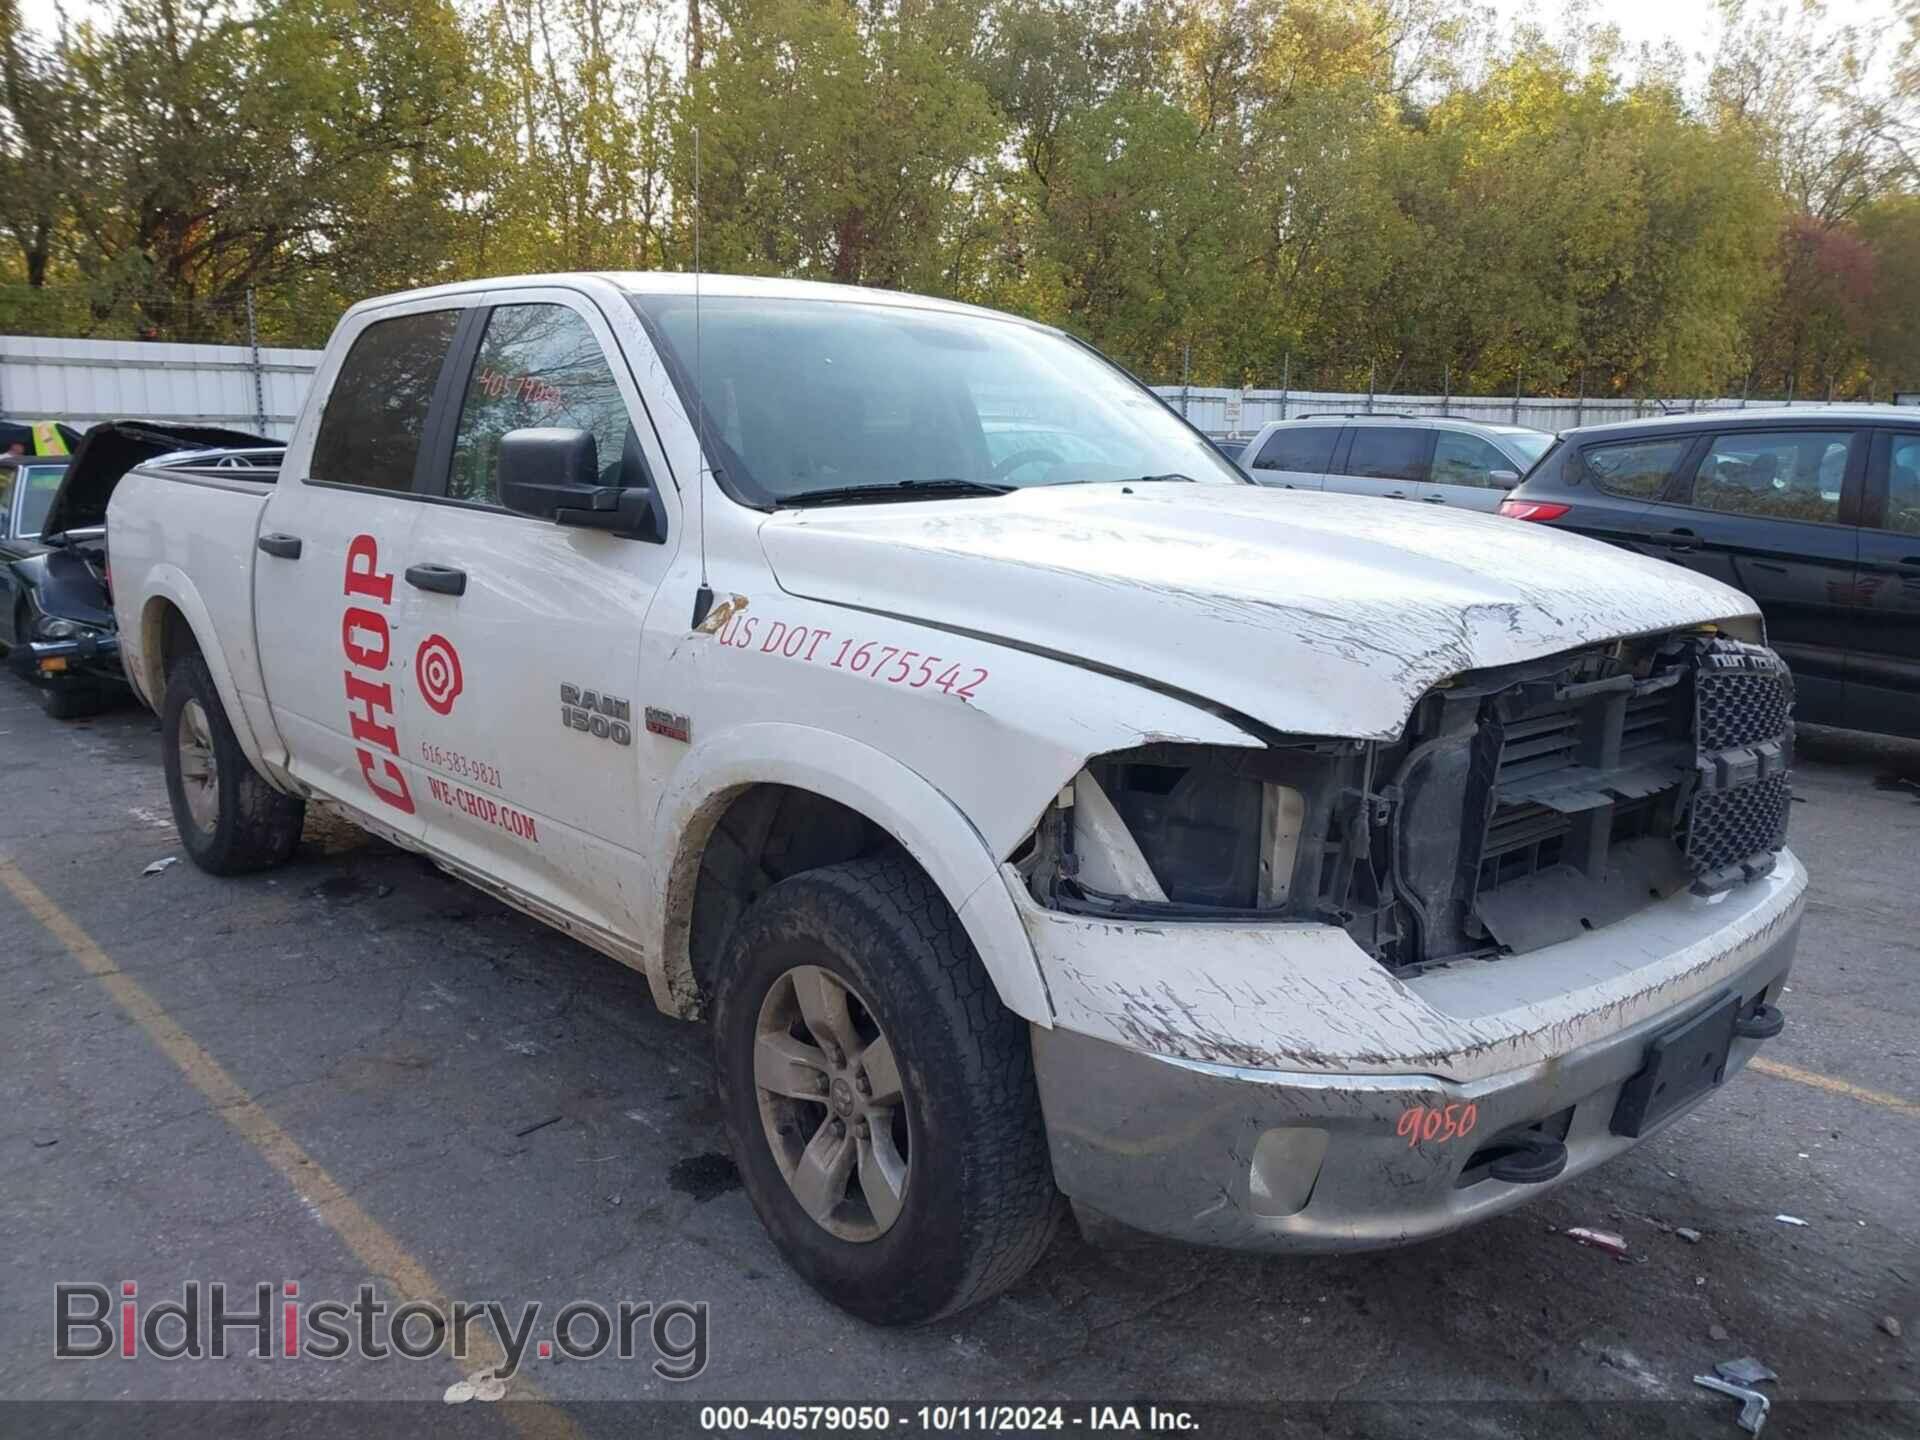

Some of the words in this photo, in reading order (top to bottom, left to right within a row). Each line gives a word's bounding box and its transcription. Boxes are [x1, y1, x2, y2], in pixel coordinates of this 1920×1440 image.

[342, 534, 416, 815] CHOP
[760, 621, 831, 661] DOT
[831, 638, 988, 698] 1675542
[560, 681, 630, 722] RAM
[560, 703, 632, 747] 1500
[421, 741, 503, 790] 616-583-9821
[427, 776, 539, 843] WE-CHOP.COM
[1397, 1104, 1477, 1148] 9050
